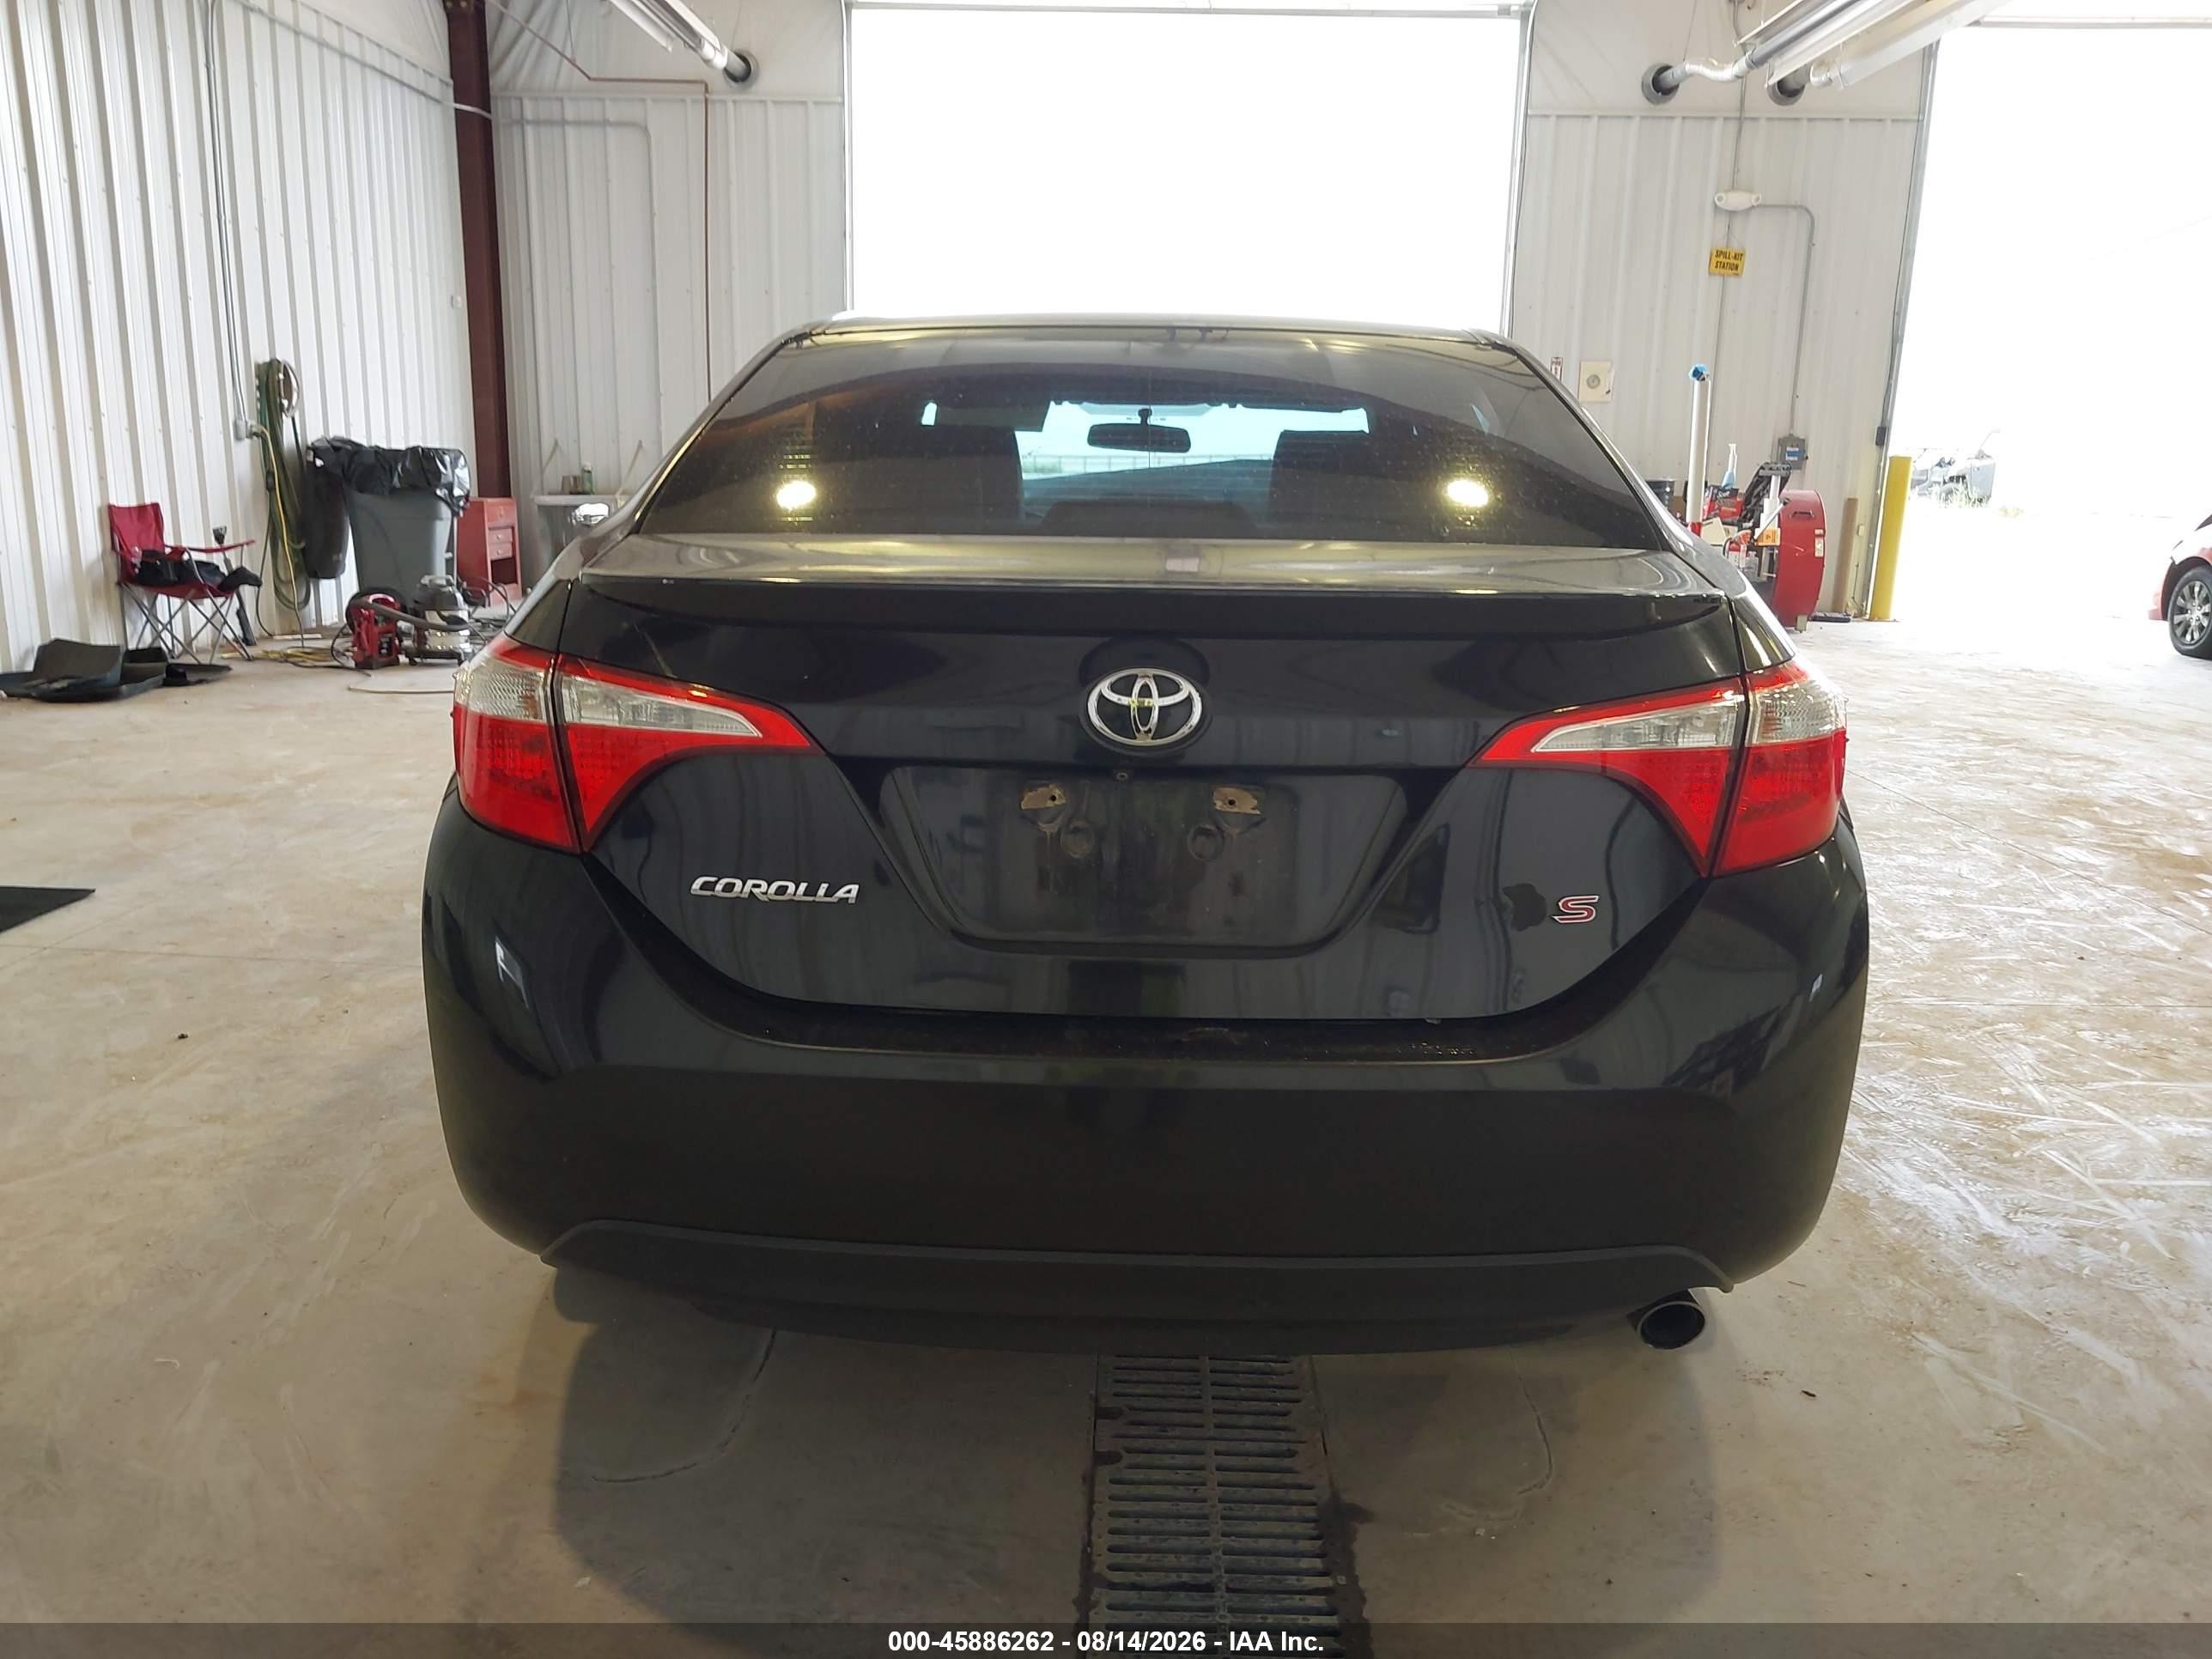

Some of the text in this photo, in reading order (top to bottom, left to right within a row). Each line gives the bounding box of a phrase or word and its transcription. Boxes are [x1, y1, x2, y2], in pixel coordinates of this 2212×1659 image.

[1715, 260, 1740, 271] STATION
[690, 876, 860, 904] COROLLA
[1551, 895, 1600, 924] S
